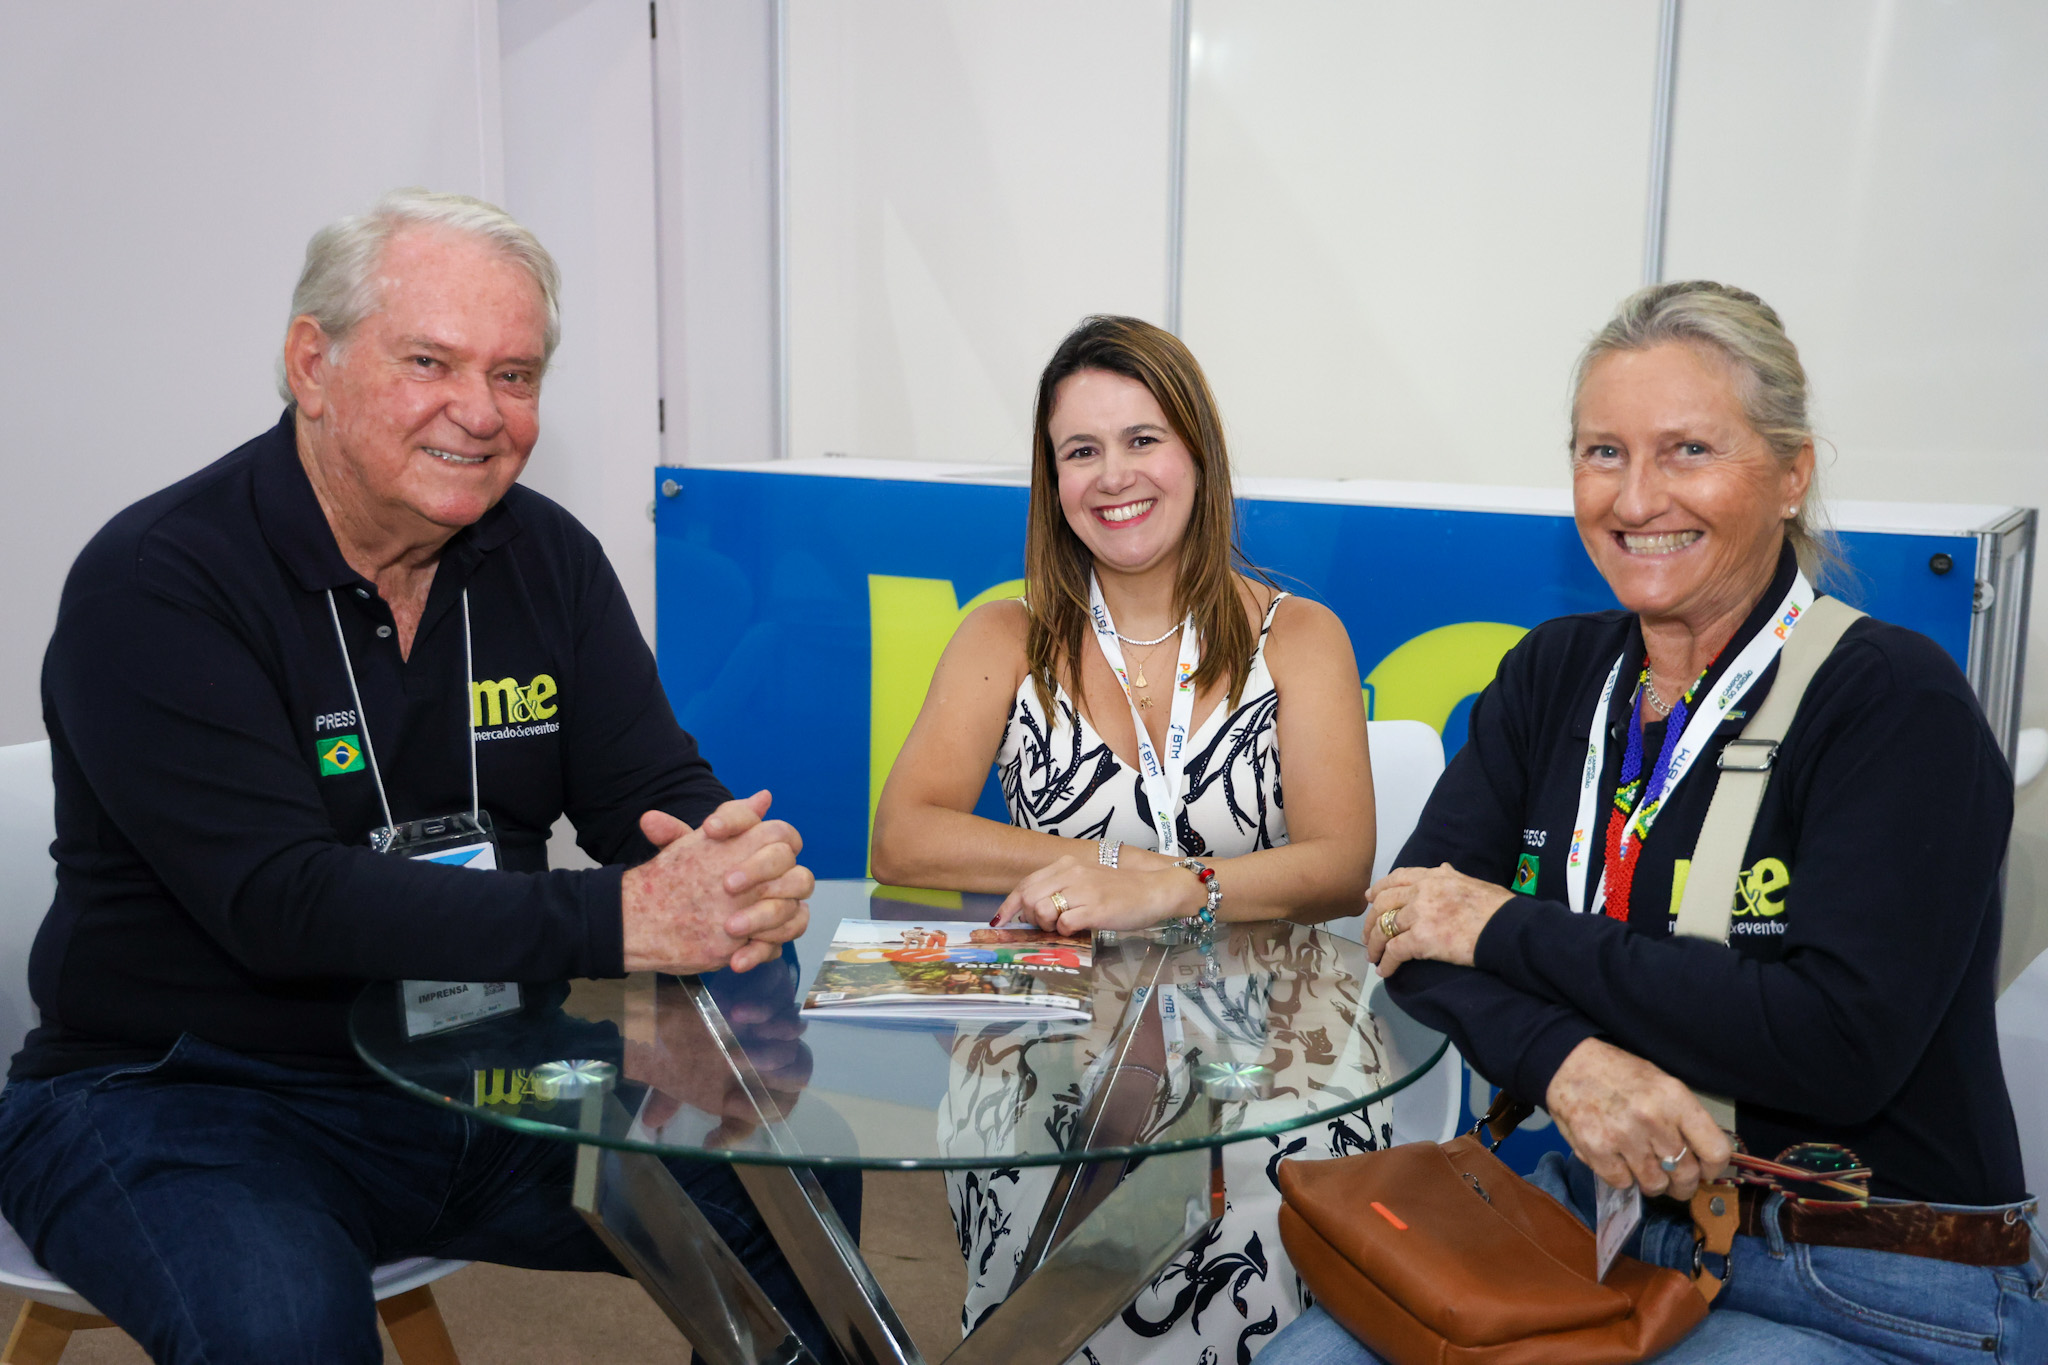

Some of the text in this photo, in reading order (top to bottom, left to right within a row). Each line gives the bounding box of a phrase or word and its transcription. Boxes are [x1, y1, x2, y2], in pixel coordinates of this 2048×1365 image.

[1722, 672, 1743, 696] CAMPOS
[1727, 690, 1736, 699] DO
[316, 710, 356, 732] PRESS
[1171, 734, 1183, 759] BTM
[1143, 750, 1158, 777] BTM
[1667, 747, 1690, 780] BTM
[1165, 822, 1173, 844] CAMPOS
[1523, 829, 1547, 847] ESS
[955, 962, 1080, 975] fascinante
[418, 984, 469, 1004] IMPRENSA
